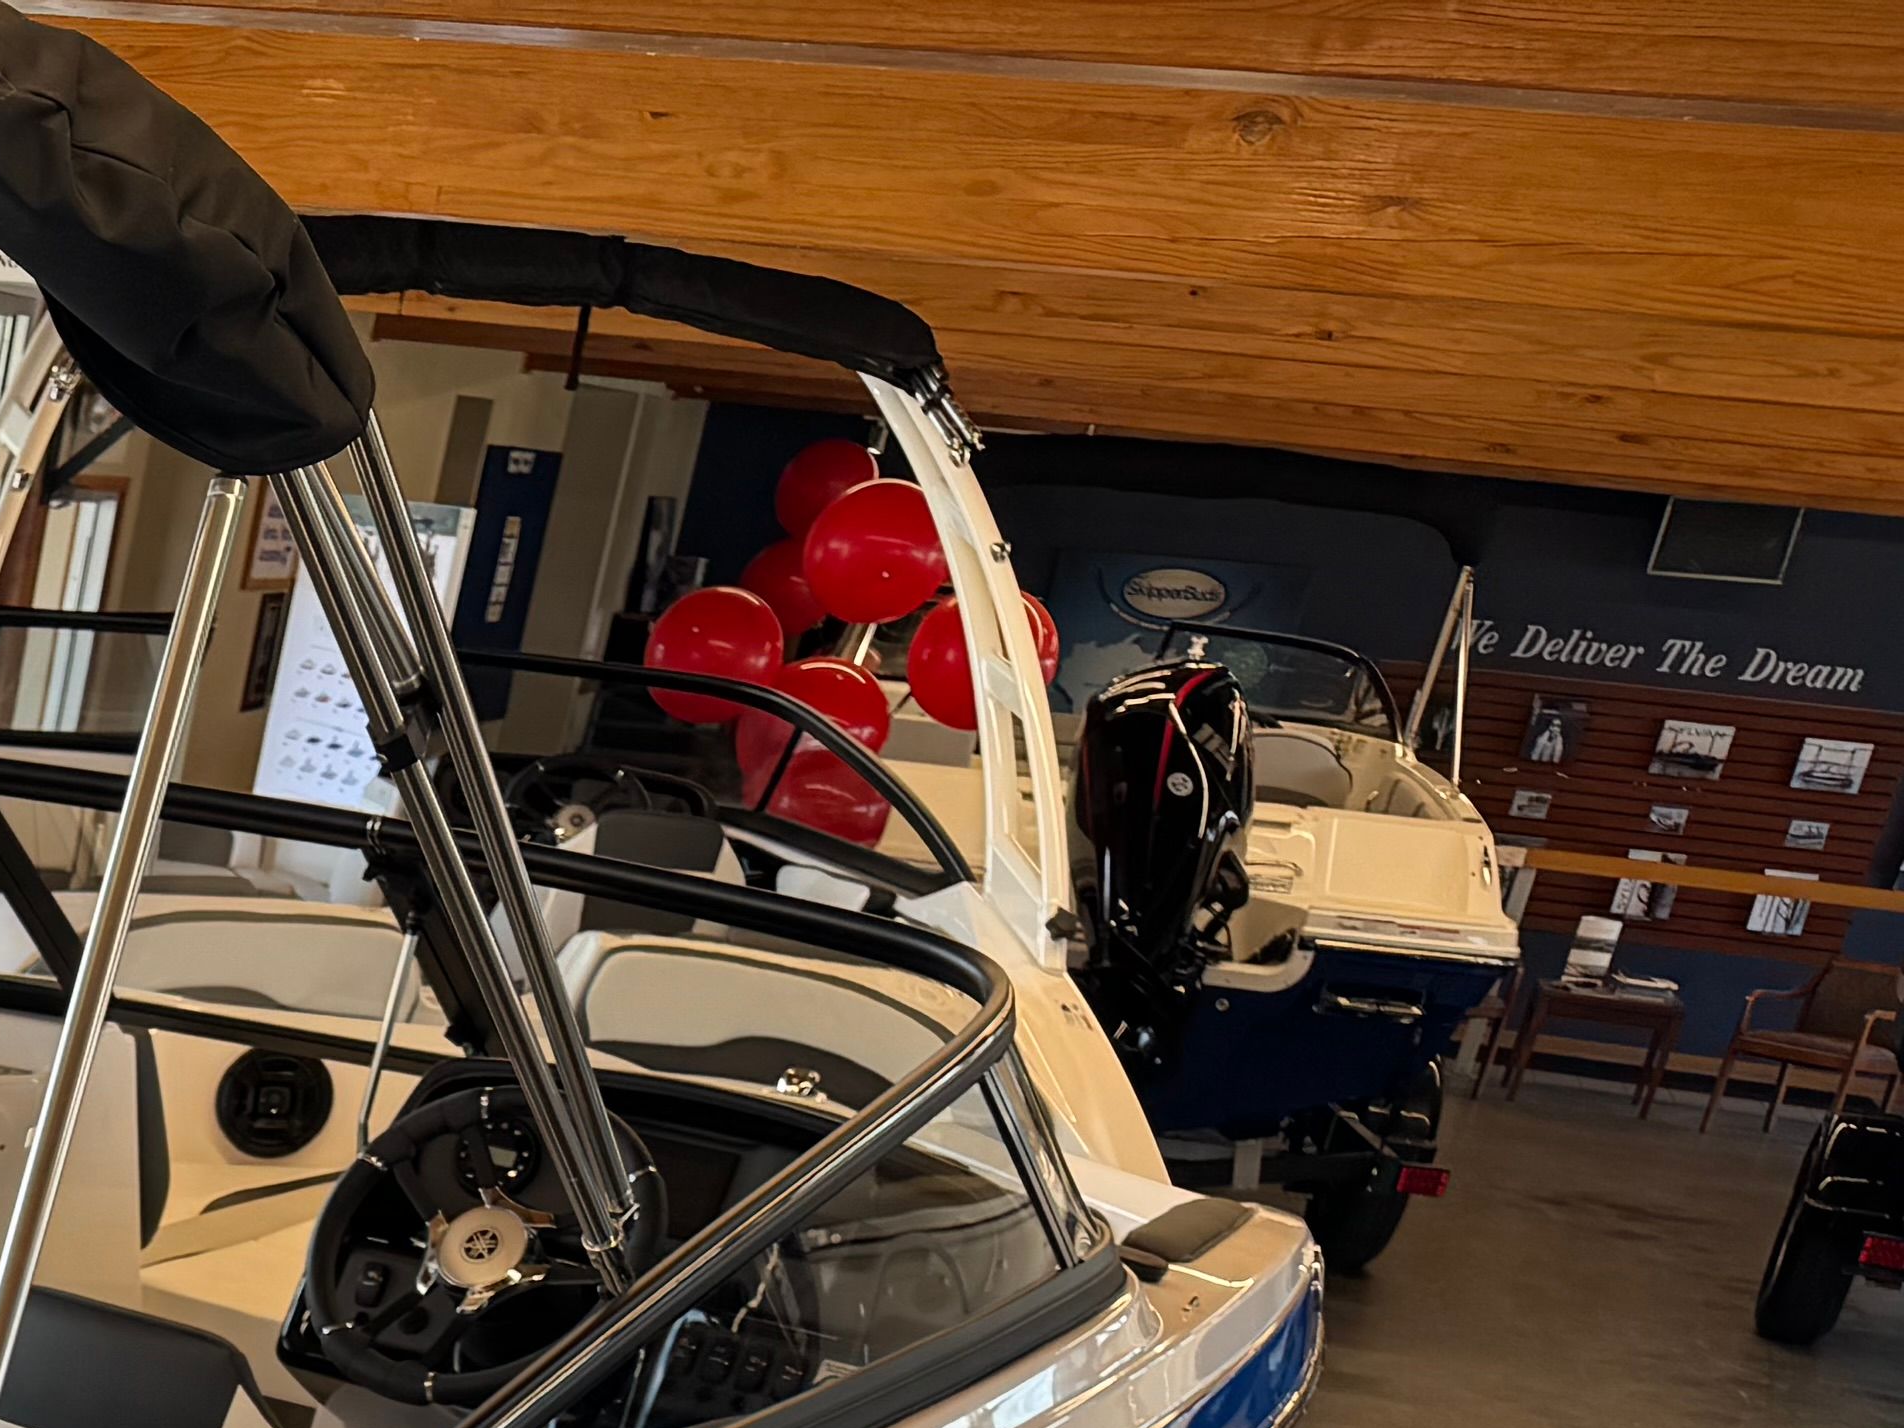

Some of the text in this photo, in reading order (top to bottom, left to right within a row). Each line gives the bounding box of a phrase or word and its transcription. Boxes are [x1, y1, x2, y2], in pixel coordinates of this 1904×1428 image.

[1511, 624, 1645, 671] Deliver
[1657, 638, 1728, 679] The
[1738, 647, 1866, 693] Dream
